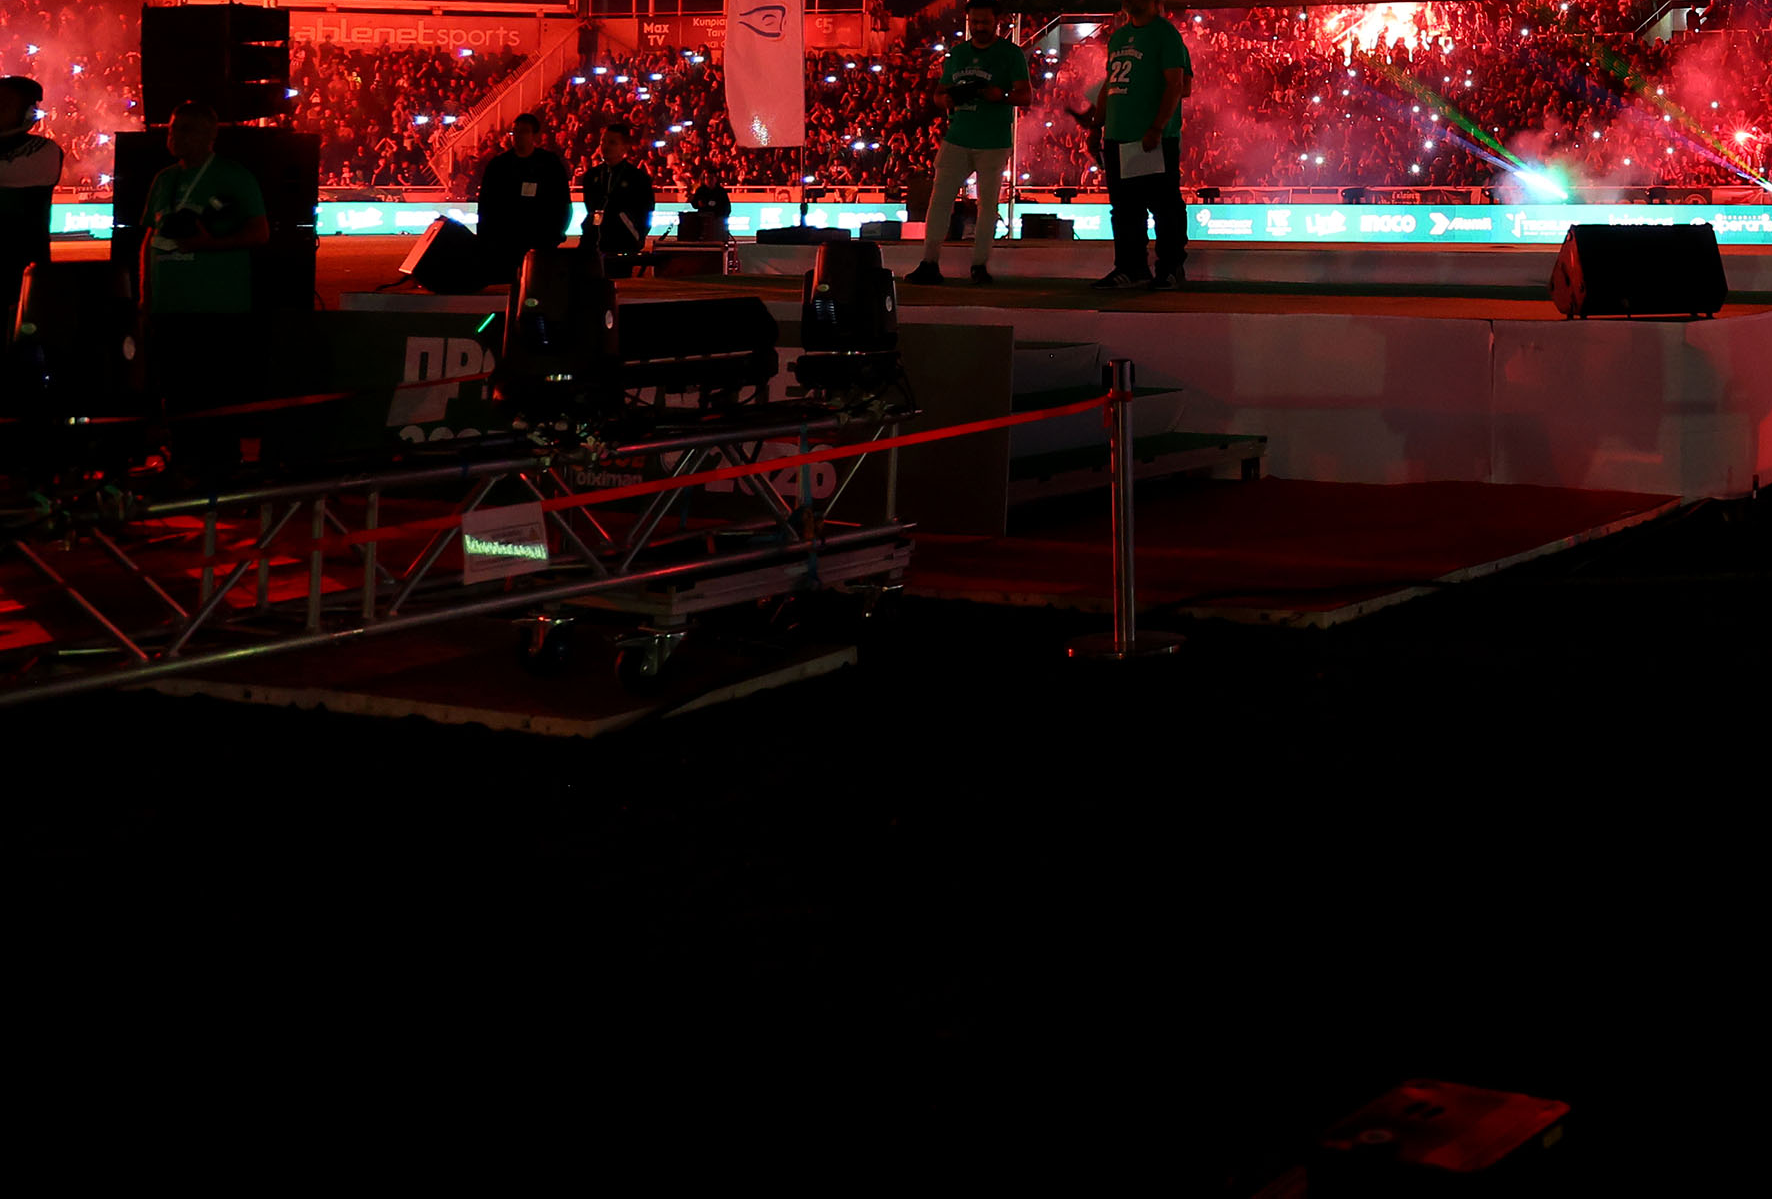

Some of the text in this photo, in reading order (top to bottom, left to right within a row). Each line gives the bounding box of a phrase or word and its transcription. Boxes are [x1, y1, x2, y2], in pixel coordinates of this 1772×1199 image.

[643, 22, 670, 34] Max
[648, 34, 665, 47] TV
[1110, 60, 1132, 83] 22
